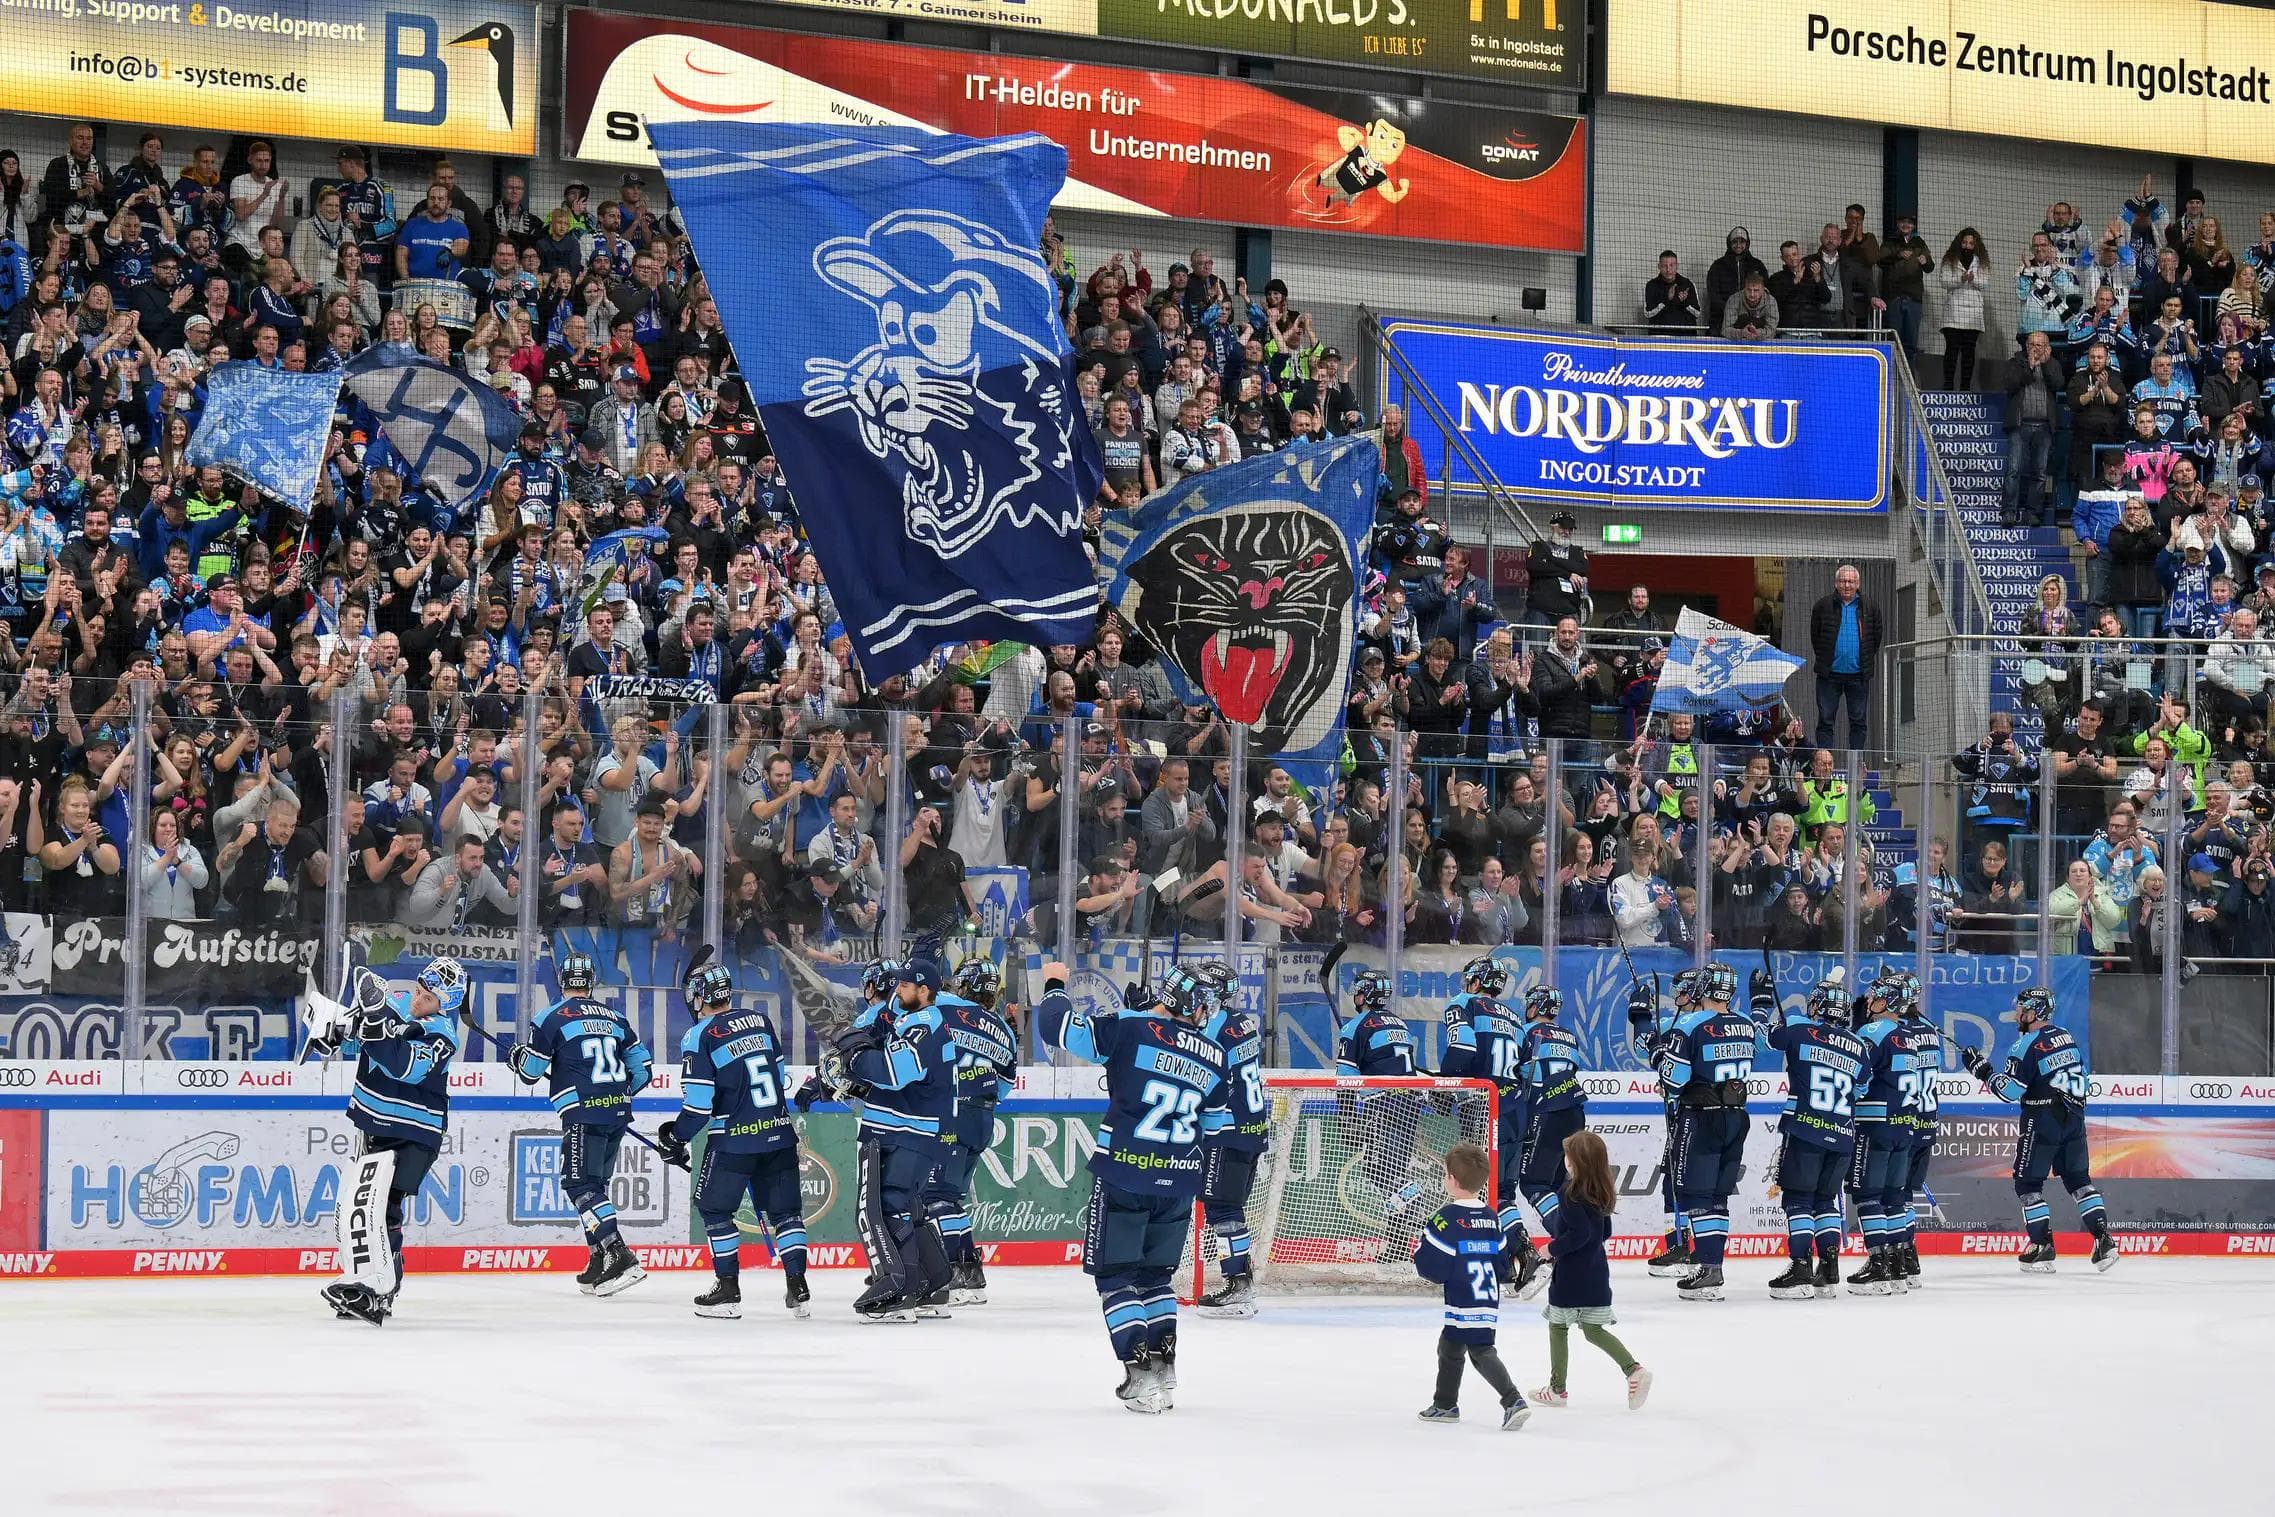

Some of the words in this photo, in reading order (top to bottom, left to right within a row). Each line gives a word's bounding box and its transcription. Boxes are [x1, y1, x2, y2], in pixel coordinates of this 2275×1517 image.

[188, 4, 207, 26] &
[216, 7, 365, 42] Development
[920, 3, 1042, 25] Gaimersheim
[1364, 36, 1379, 54] ICH
[1383, 36, 1407, 56] LIEBE
[1470, 34, 1485, 49] 5x
[1488, 37, 1500, 50] in
[1503, 38, 1565, 57] Ingolstadt
[1470, 53, 1563, 73] www.mcdonalds.de
[1808, 14, 1947, 66] Porsche
[1956, 32, 2096, 84] Zentrum
[2106, 49, 2271, 104] Ingolstadt
[69, 51, 307, 94] info@b1-systems.de
[966, 74, 1092, 112] IT-Helden
[1100, 89, 1141, 117] für
[1089, 129, 1271, 172] Unternehmen
[1482, 145, 1540, 162] DONAT
[1542, 351, 1706, 390] Privatbrauerei
[1919, 393, 1982, 406] ORDBRÄU
[1457, 381, 1800, 459] NORDBRÄU
[1924, 407, 1987, 420] ORDBRÄU
[1930, 423, 1993, 436] ORDBRÄU
[1935, 441, 1998, 454] ORDBRÄU
[1539, 459, 1705, 488] INGOLSTADT
[1940, 458, 2003, 472] ORDBRÄU
[1964, 528, 2029, 542] ORDBRÄU
[1971, 547, 2036, 561] ORDBRÄU
[1977, 564, 2042, 578] ORDBRÄU
[154, 924, 319, 974] Aufstieg
[728, 1012, 765, 1033] SATURN
[978, 1017, 1010, 1049] SATURN
[727, 1036, 766, 1058] WAGNER
[951, 1030, 1012, 1066] STACHOWIAK
[1176, 1031, 1223, 1067] SATURN
[1714, 1044, 1754, 1059] BERTRAN
[1828, 1033, 1863, 1058] SATURN
[46, 1070, 101, 1086] Audi
[238, 1070, 293, 1086] Audi
[450, 1072, 484, 1087] udi
[649, 1073, 671, 1089] di
[744, 1054, 777, 1108] 5
[1155, 1052, 1213, 1090] EDWARDS
[1434, 1079, 1463, 1087] PENNY.
[1810, 1065, 1852, 1117] 52
[2109, 1082, 2153, 1097] Audi
[1134, 1079, 1202, 1144] 23
[1592, 1124, 1650, 1135] BAUER
[1956, 1122, 1999, 1138] PUCK
[1113, 1148, 1200, 1172] zieglerhaus
[1932, 1142, 1970, 1157] DICH
[71, 1161, 465, 1229] HOFMAN
[1749, 1206, 1765, 1215] IHR
[1605, 1236, 1661, 1256] ENNY.
[2227, 1236, 2275, 1253] PEN
[134, 1251, 228, 1272] PENNY.
[463, 1249, 552, 1269] PENNY.
[634, 1248, 704, 1269] ENNY.
[1467, 1261, 1498, 1301] 23
